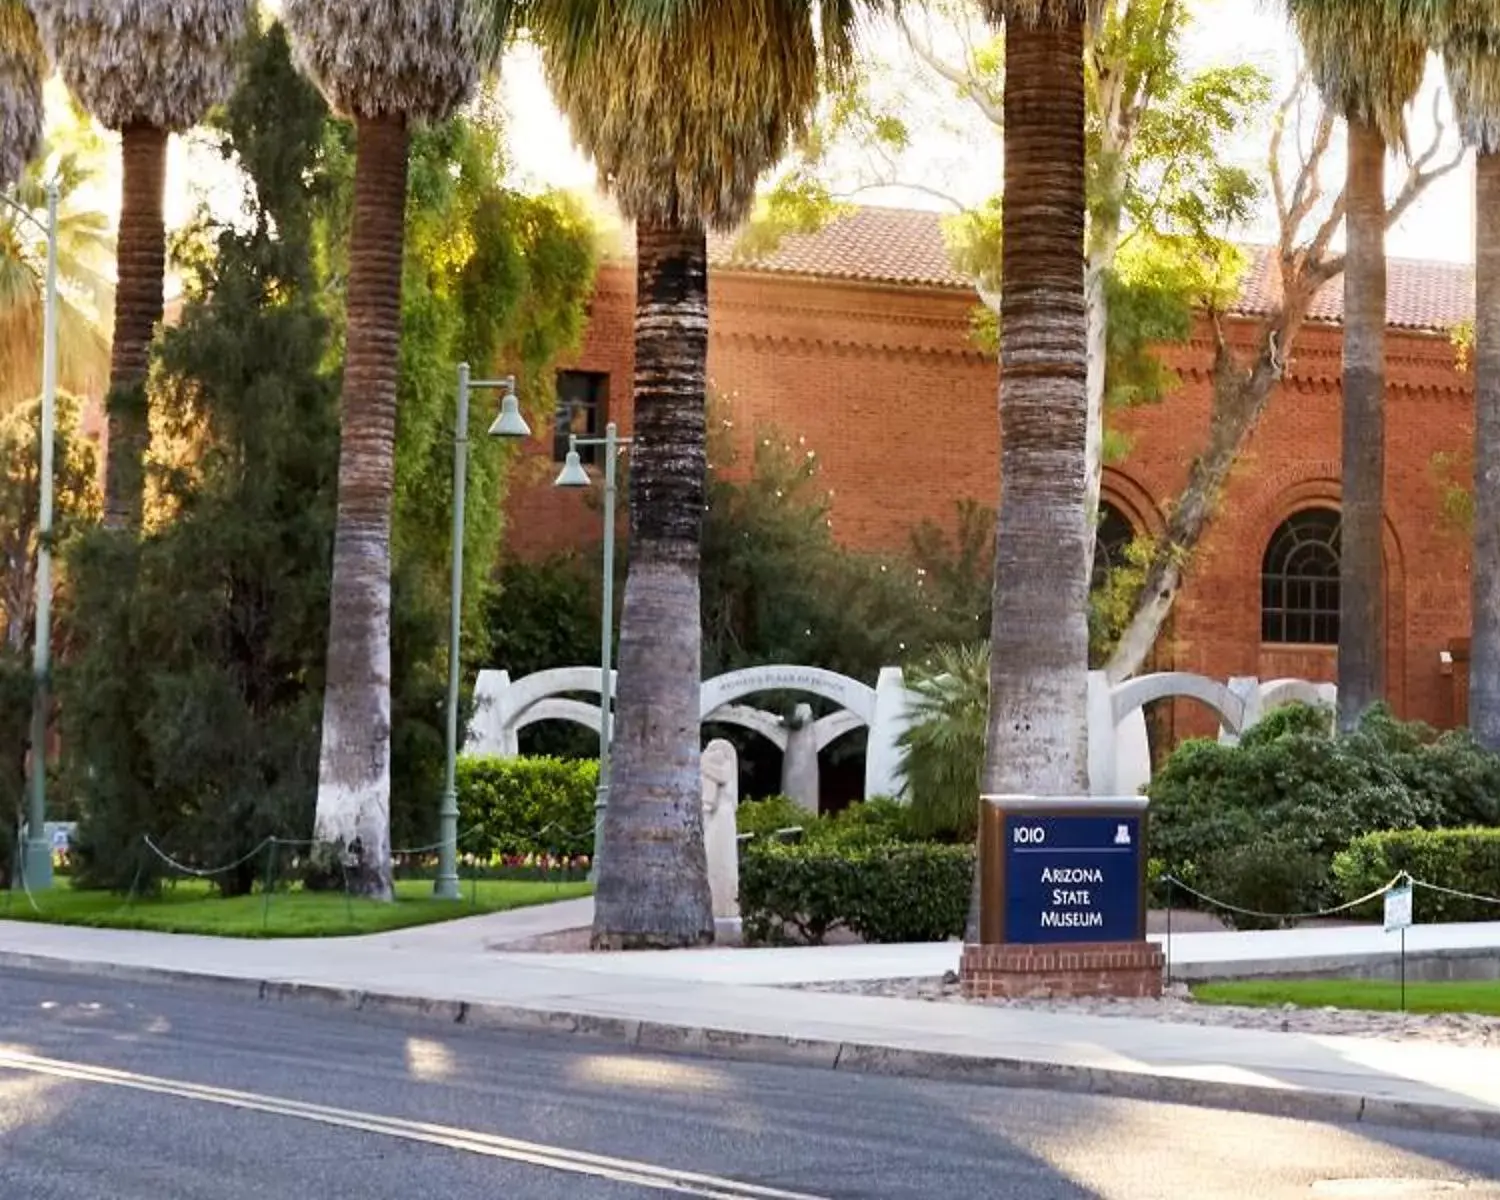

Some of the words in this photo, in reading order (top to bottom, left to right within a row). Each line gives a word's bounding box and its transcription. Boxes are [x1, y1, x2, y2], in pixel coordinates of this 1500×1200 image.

[1013, 826, 1045, 844] 1010
[1041, 867, 1103, 883] ARIZONA
[1053, 889, 1091, 905] STATE
[1041, 911, 1103, 927] MUSEUM
